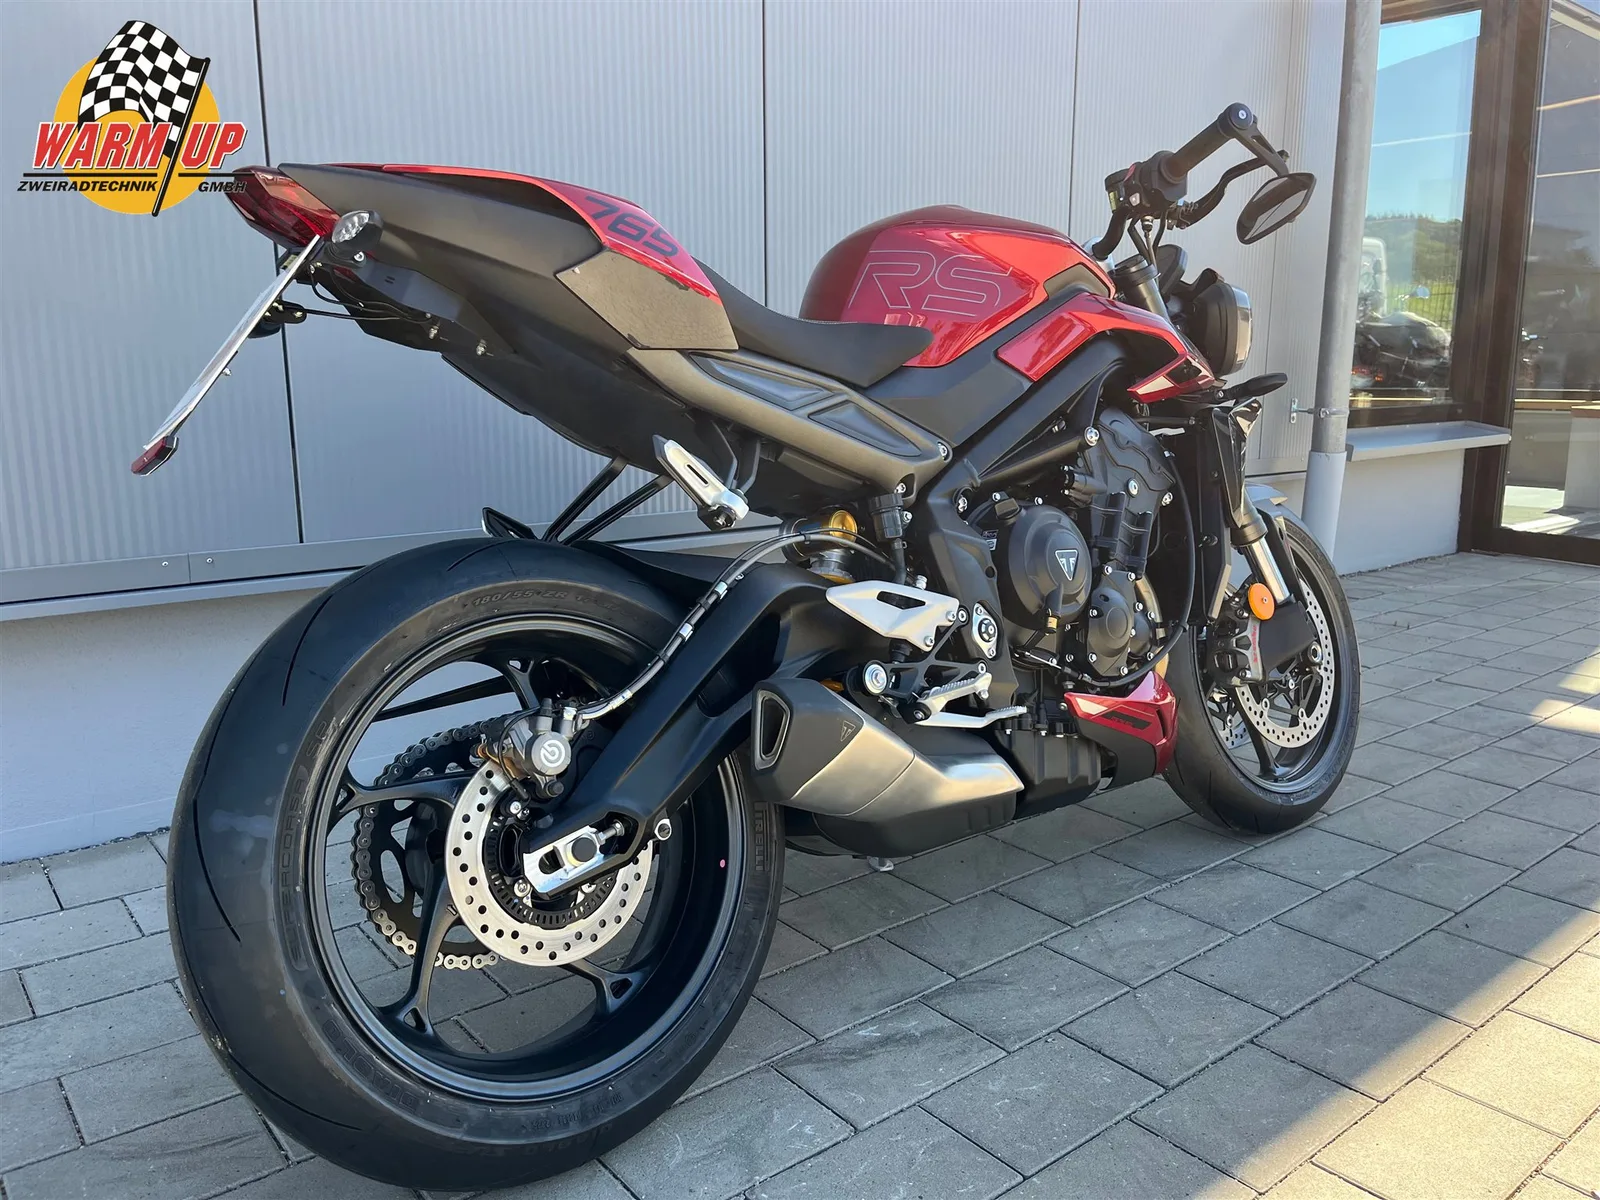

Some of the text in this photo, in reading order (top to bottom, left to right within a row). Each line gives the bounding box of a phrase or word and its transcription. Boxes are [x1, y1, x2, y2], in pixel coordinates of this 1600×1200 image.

[585, 195, 679, 257] 765
[848, 250, 1013, 317] RS
[473, 589, 535, 607] 180/55
[280, 776, 309, 961] SUPERCORSA
[753, 802, 769, 871] PIRELLI
[322, 1019, 420, 1112] DIABLO
